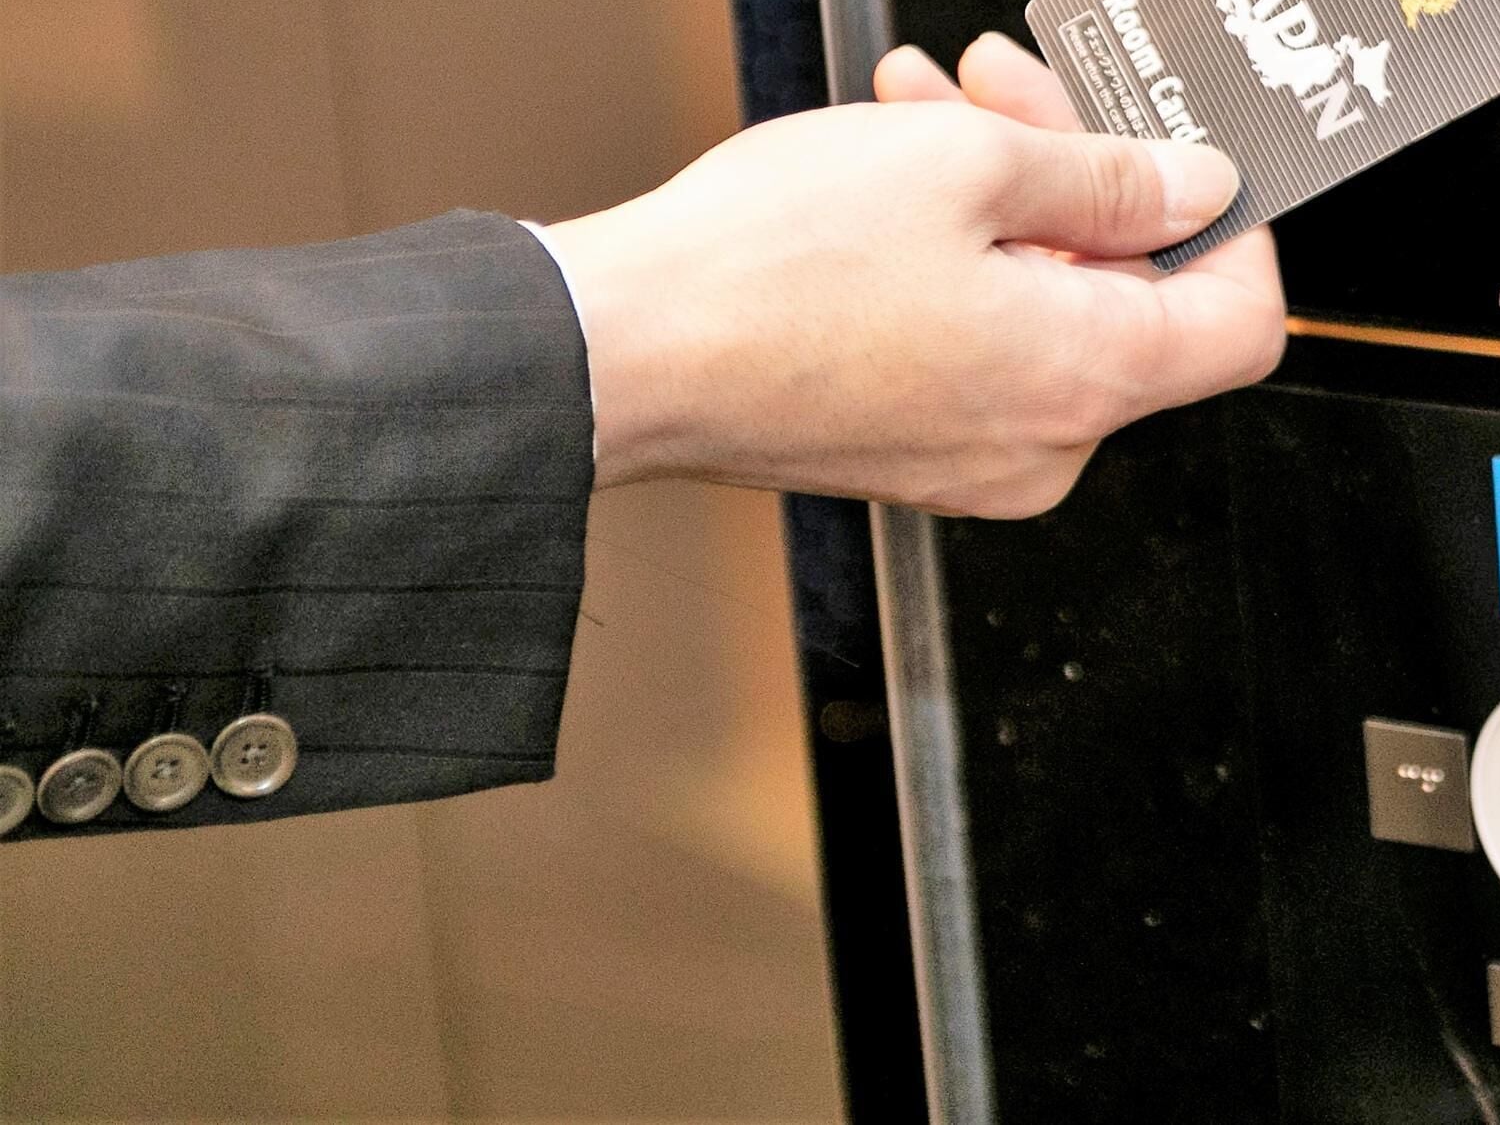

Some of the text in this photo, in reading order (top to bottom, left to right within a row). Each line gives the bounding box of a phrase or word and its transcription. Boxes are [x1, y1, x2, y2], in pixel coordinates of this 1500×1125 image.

[1082, 57, 1103, 89] return
[1099, 87, 1115, 109] this
[1109, 108, 1128, 132] card
[1149, 75, 1208, 143] Card
